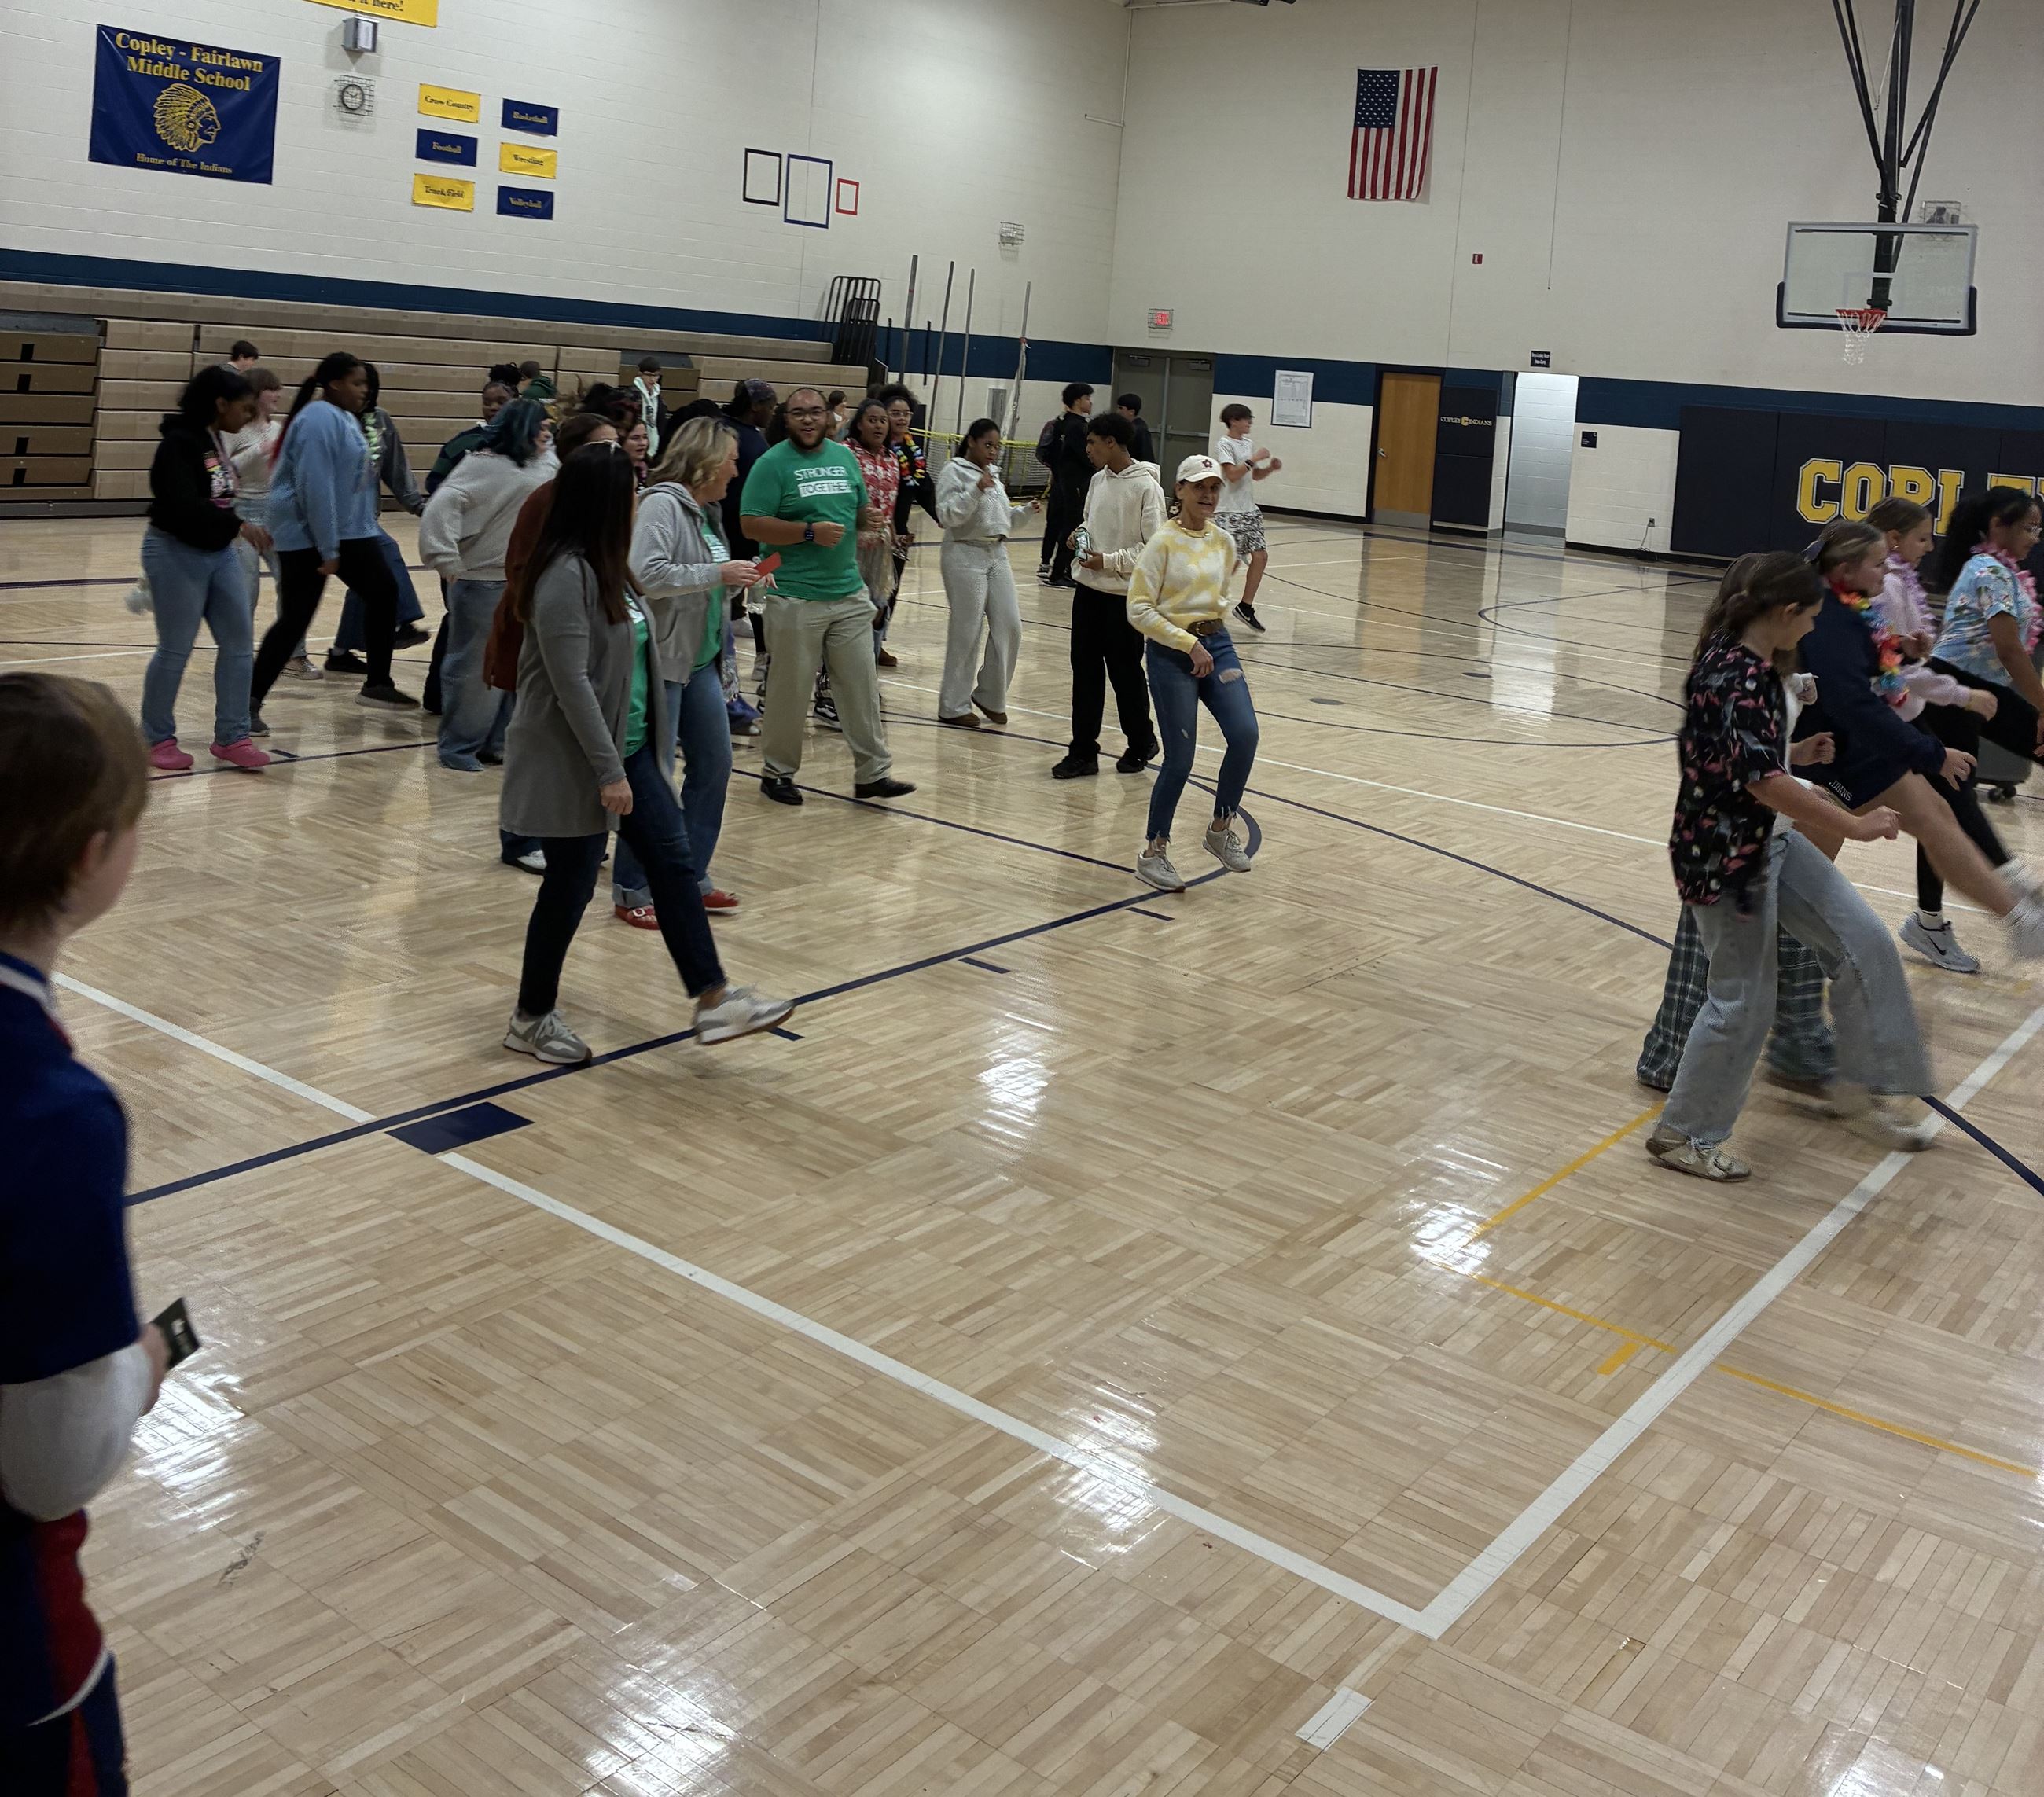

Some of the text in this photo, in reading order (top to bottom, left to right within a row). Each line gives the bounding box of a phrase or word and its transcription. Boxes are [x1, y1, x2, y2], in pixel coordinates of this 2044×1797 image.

[116, 32, 176, 61] Copley
[190, 46, 263, 72] Fairlawn
[127, 56, 251, 91] Middle School
[136, 153, 233, 174] Home of The Indians
[793, 465, 849, 480] STRONGER
[798, 480, 852, 496] TOGETHER
